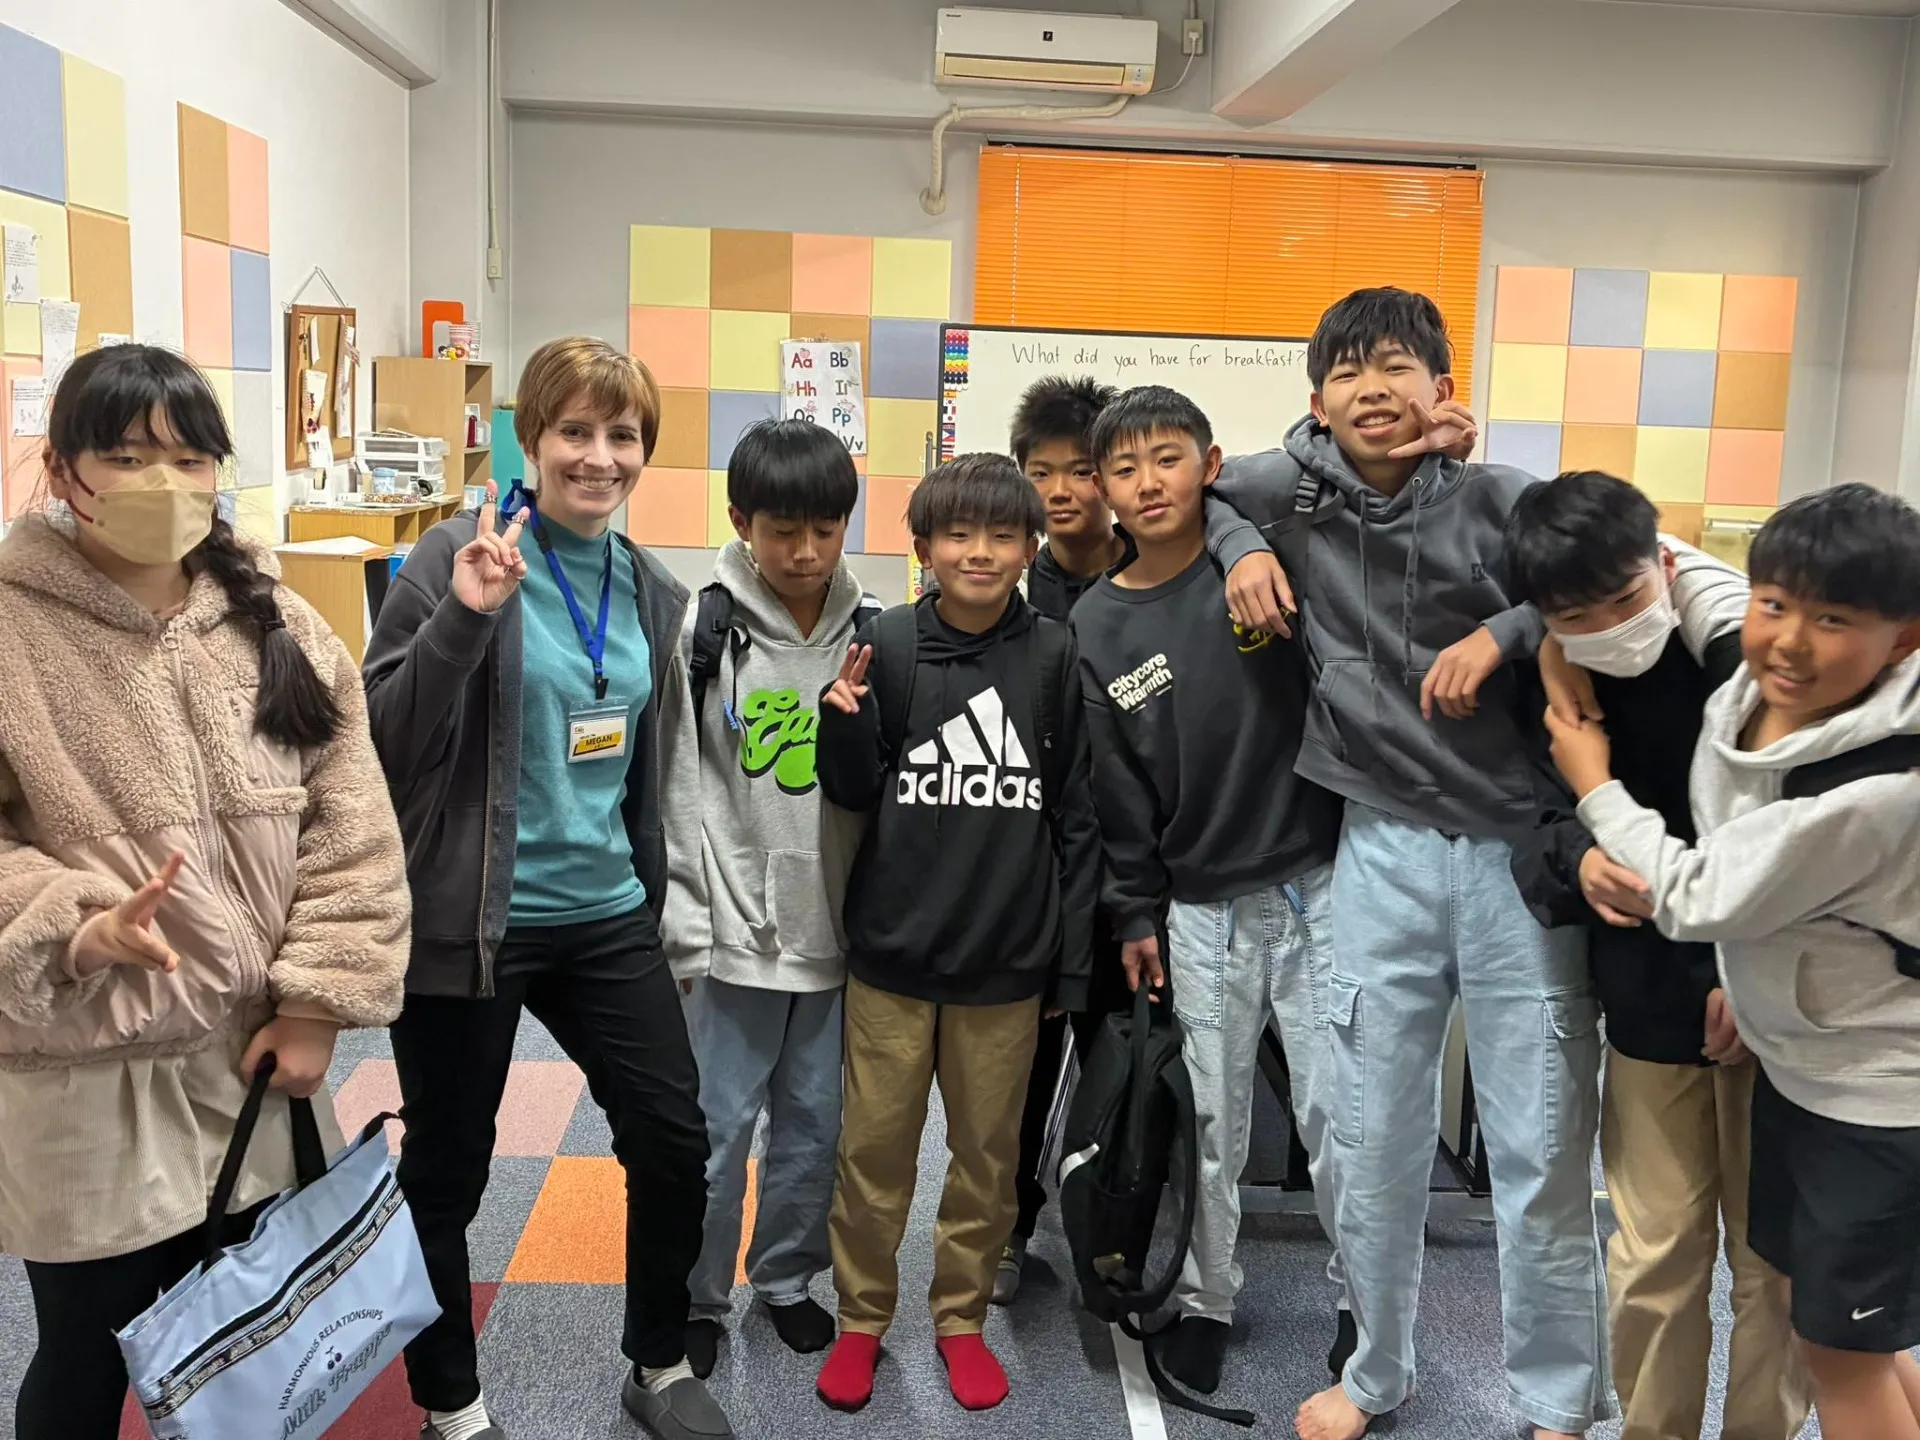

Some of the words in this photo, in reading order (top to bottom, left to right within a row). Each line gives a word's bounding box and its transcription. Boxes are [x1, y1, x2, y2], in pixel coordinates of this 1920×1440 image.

[791, 352, 813, 369] Aa
[830, 352, 849, 368] Bb
[1011, 343, 1059, 364] What
[1073, 348, 1098, 364] did
[1114, 349, 1138, 376] you
[1150, 348, 1180, 365] have
[1189, 344, 1212, 365] for
[1224, 347, 1305, 368] breakfast?
[796, 381, 817, 397] Hh
[832, 408, 851, 427] Pp
[843, 436, 863, 451] Vv
[1107, 653, 1167, 698] Citycore
[1116, 667, 1174, 711] Warmth
[586, 735, 612, 746] MEGAN
[897, 762, 1043, 811] adidas
[278, 1339, 320, 1410] HARMONIOUS
[318, 1309, 384, 1342] RELATIONSHIPS
